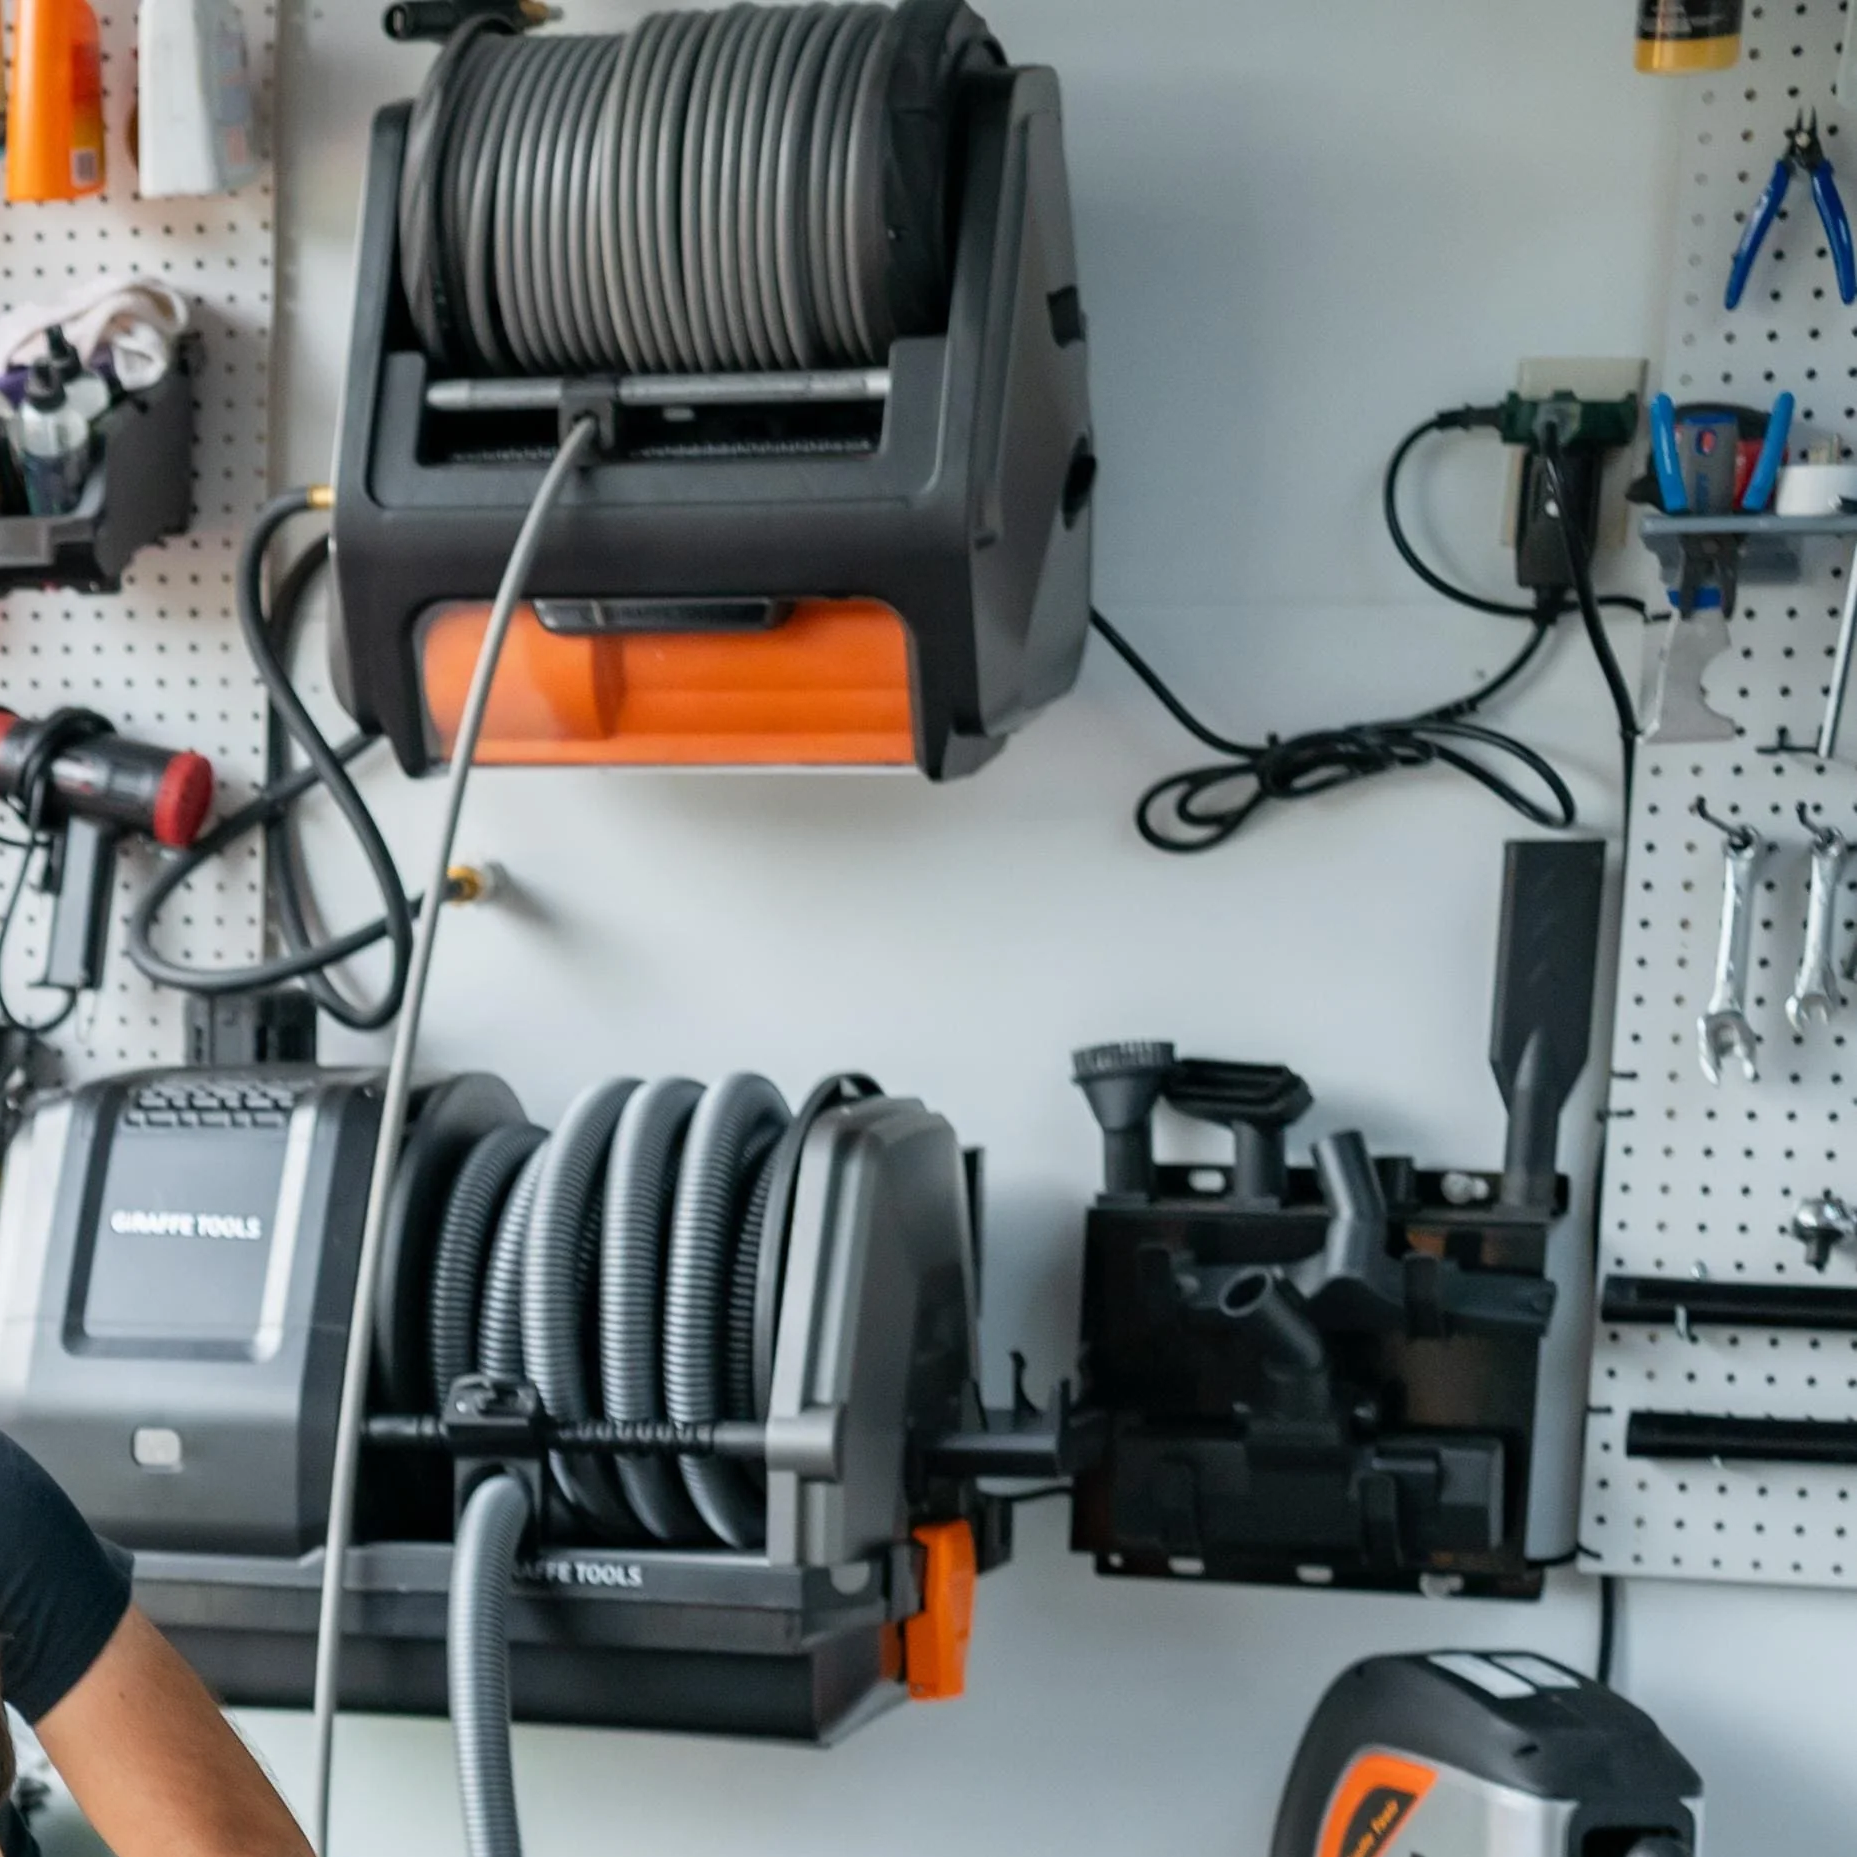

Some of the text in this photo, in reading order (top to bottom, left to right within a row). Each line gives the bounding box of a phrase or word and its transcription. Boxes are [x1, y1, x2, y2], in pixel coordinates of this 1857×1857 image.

[110, 1209, 260, 1240] GIRAFFE TOOLS
[574, 1561, 642, 1587] TOOLS
